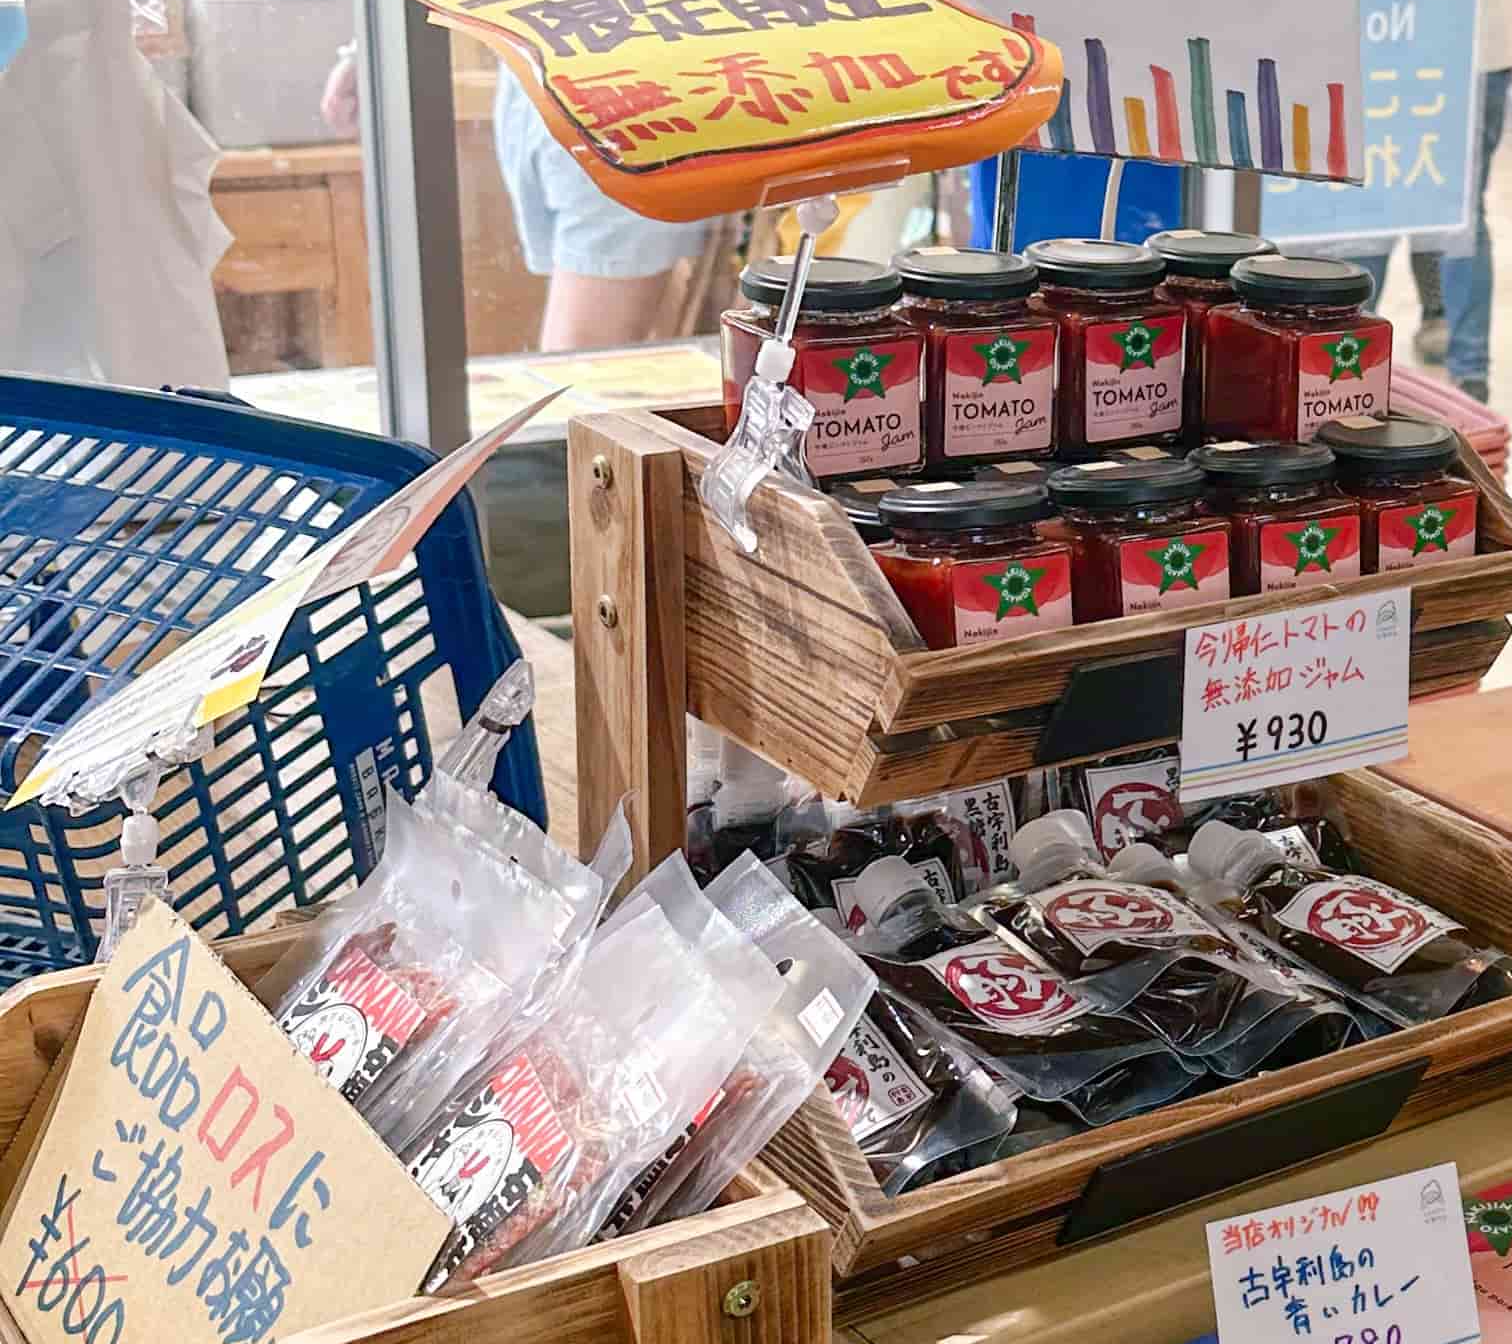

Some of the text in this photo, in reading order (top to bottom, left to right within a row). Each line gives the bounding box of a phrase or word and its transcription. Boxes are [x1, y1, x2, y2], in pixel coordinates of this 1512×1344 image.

[952, 398, 1035, 421] TOMATO
[1092, 382, 1168, 407] TOMATO
[1304, 392, 1375, 418] TOMATO
[815, 413, 901, 439] TOMATO
[881, 429, 914, 453] Jam
[1016, 416, 1048, 435] Jam
[1194, 608, 1367, 668] 今帰仁トマトの
[1201, 656, 1366, 713] 無添加ジャム
[1235, 710, 1328, 761] ¥930
[489, 1053, 573, 1175] OKINAWA
[1238, 1244, 1375, 1309] 古宇利島の
[1285, 1275, 1420, 1336] 青いカレー
